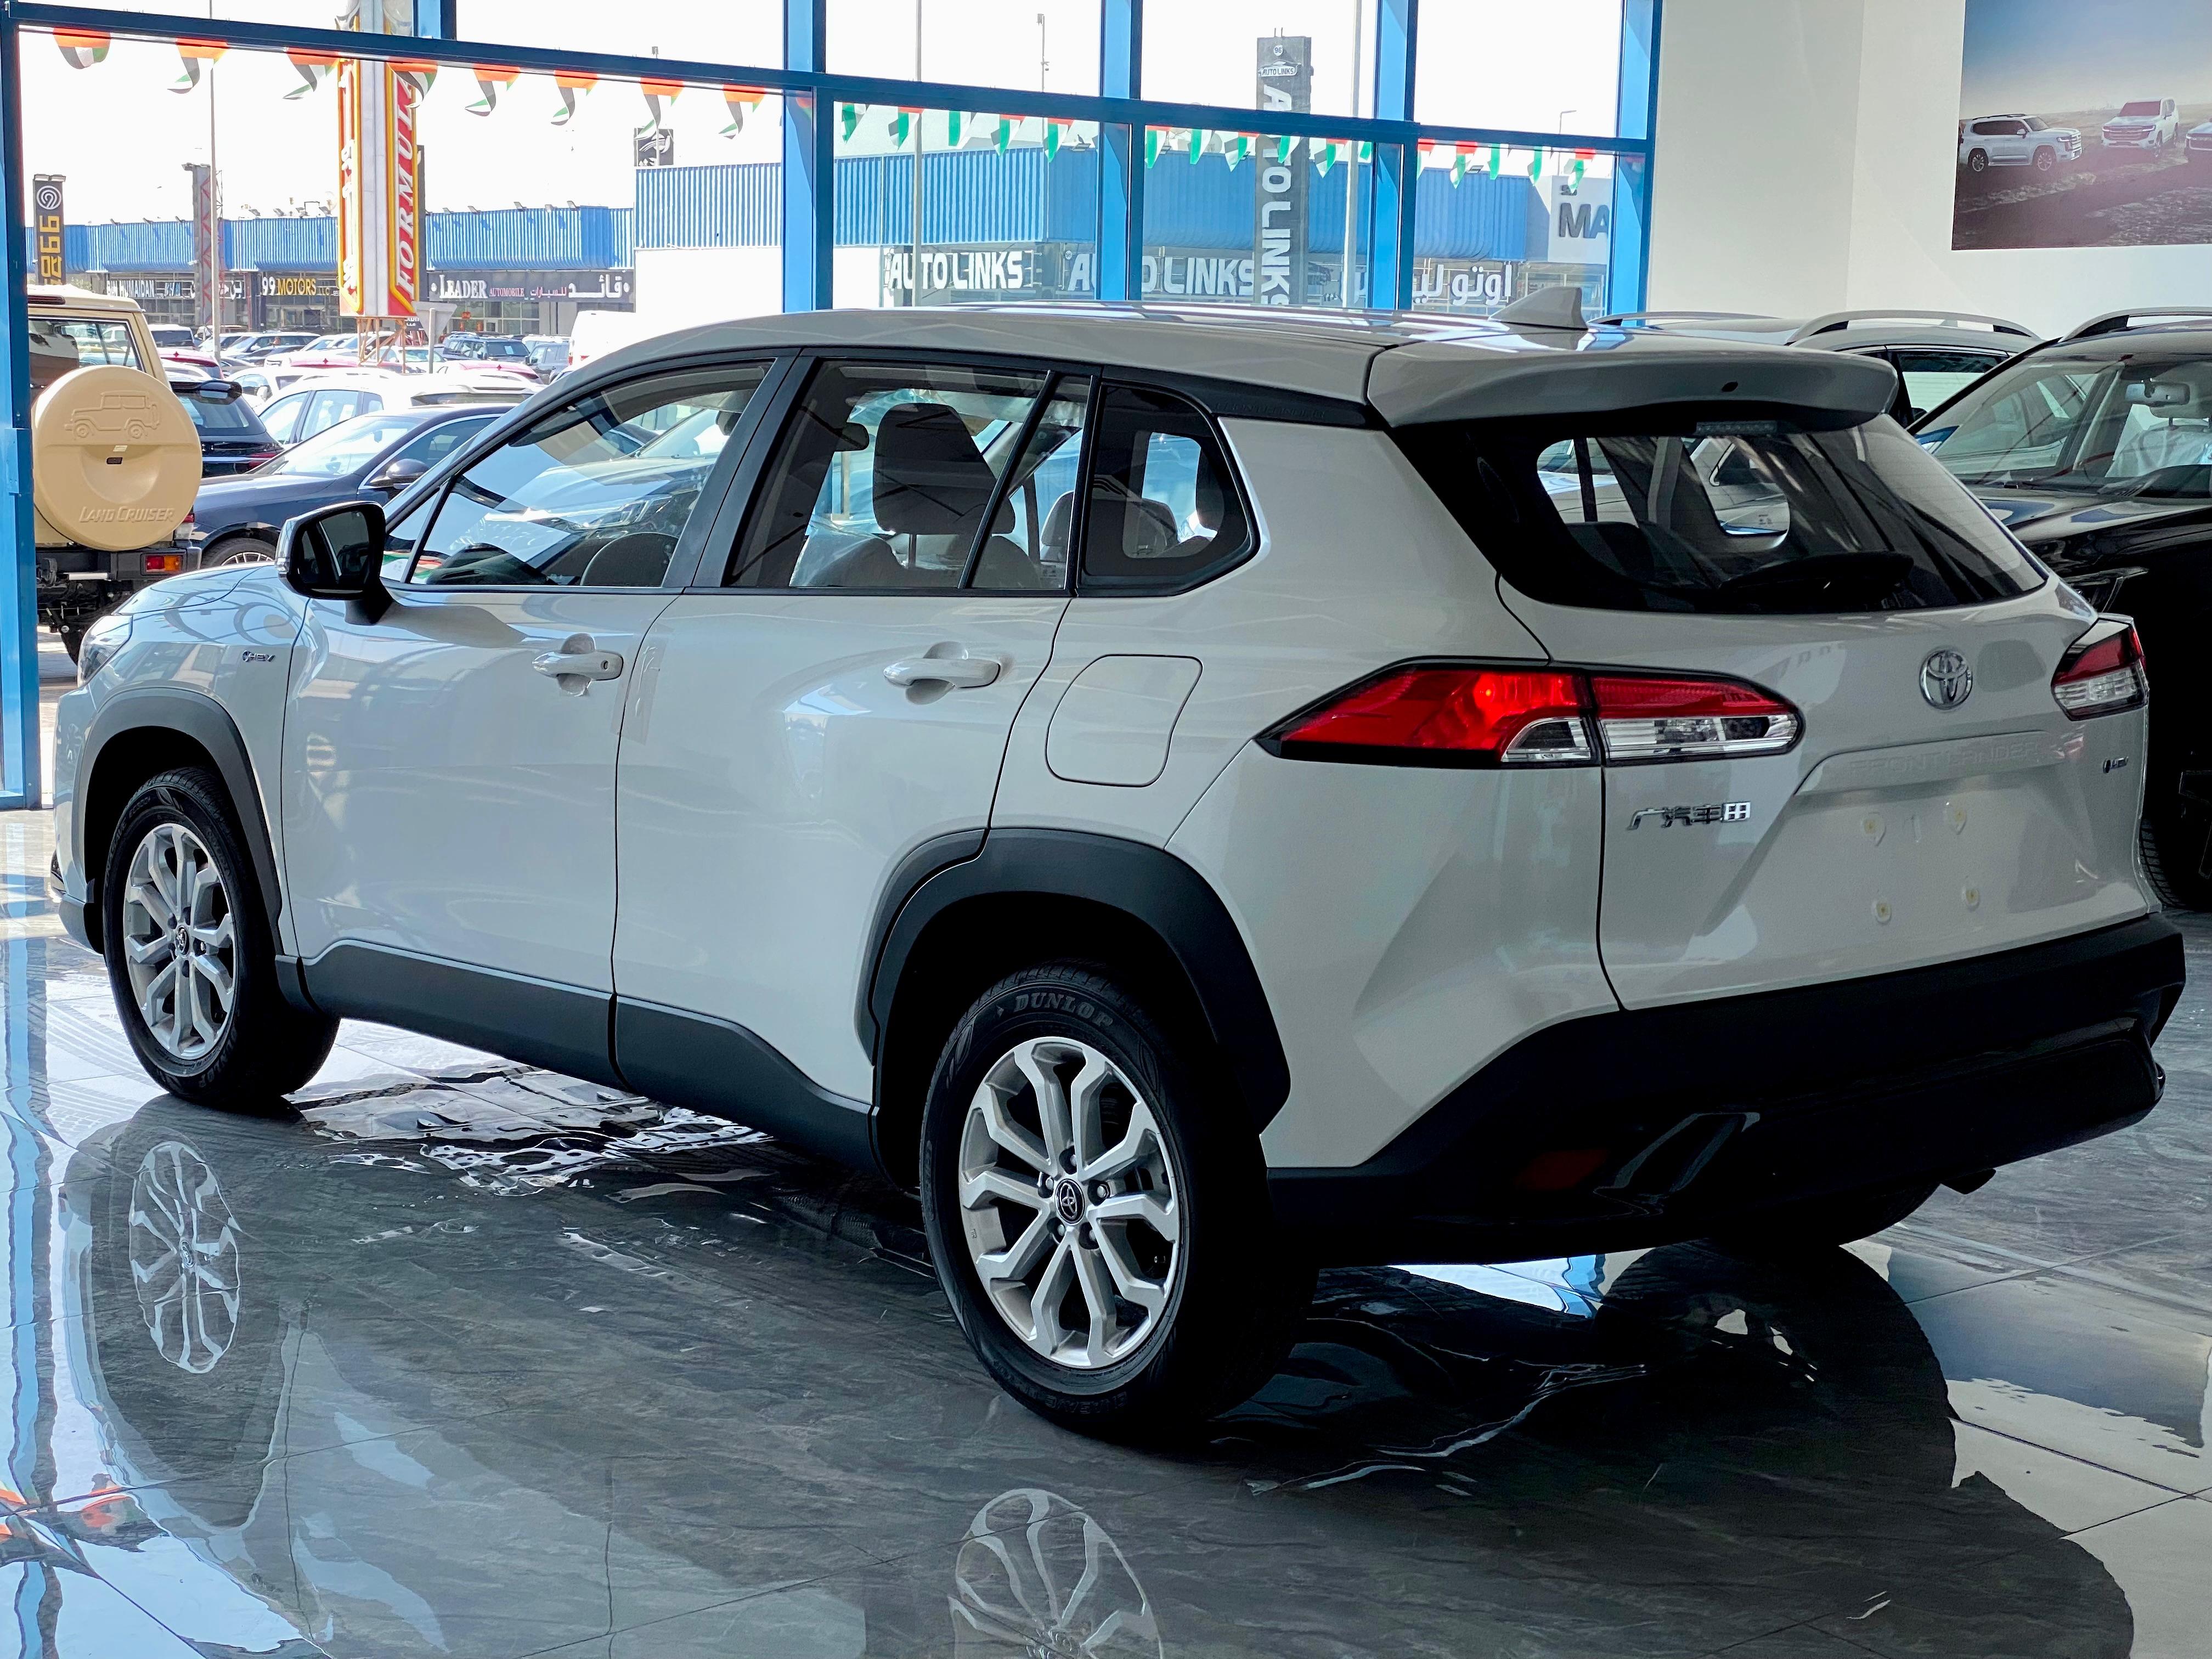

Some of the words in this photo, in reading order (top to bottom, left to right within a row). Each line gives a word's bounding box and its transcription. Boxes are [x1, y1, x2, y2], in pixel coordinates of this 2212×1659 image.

[951, 251, 1023, 290] LINKS
[262, 276, 276, 296] 99
[277, 277, 317, 296] MOTORS
[439, 274, 488, 299] LEADER
[489, 287, 525, 297] AUTOMOBILE
[79, 506, 115, 523] LAND
[116, 506, 175, 523] CRUISER
[1014, 992, 1114, 1027] DUNLOP
